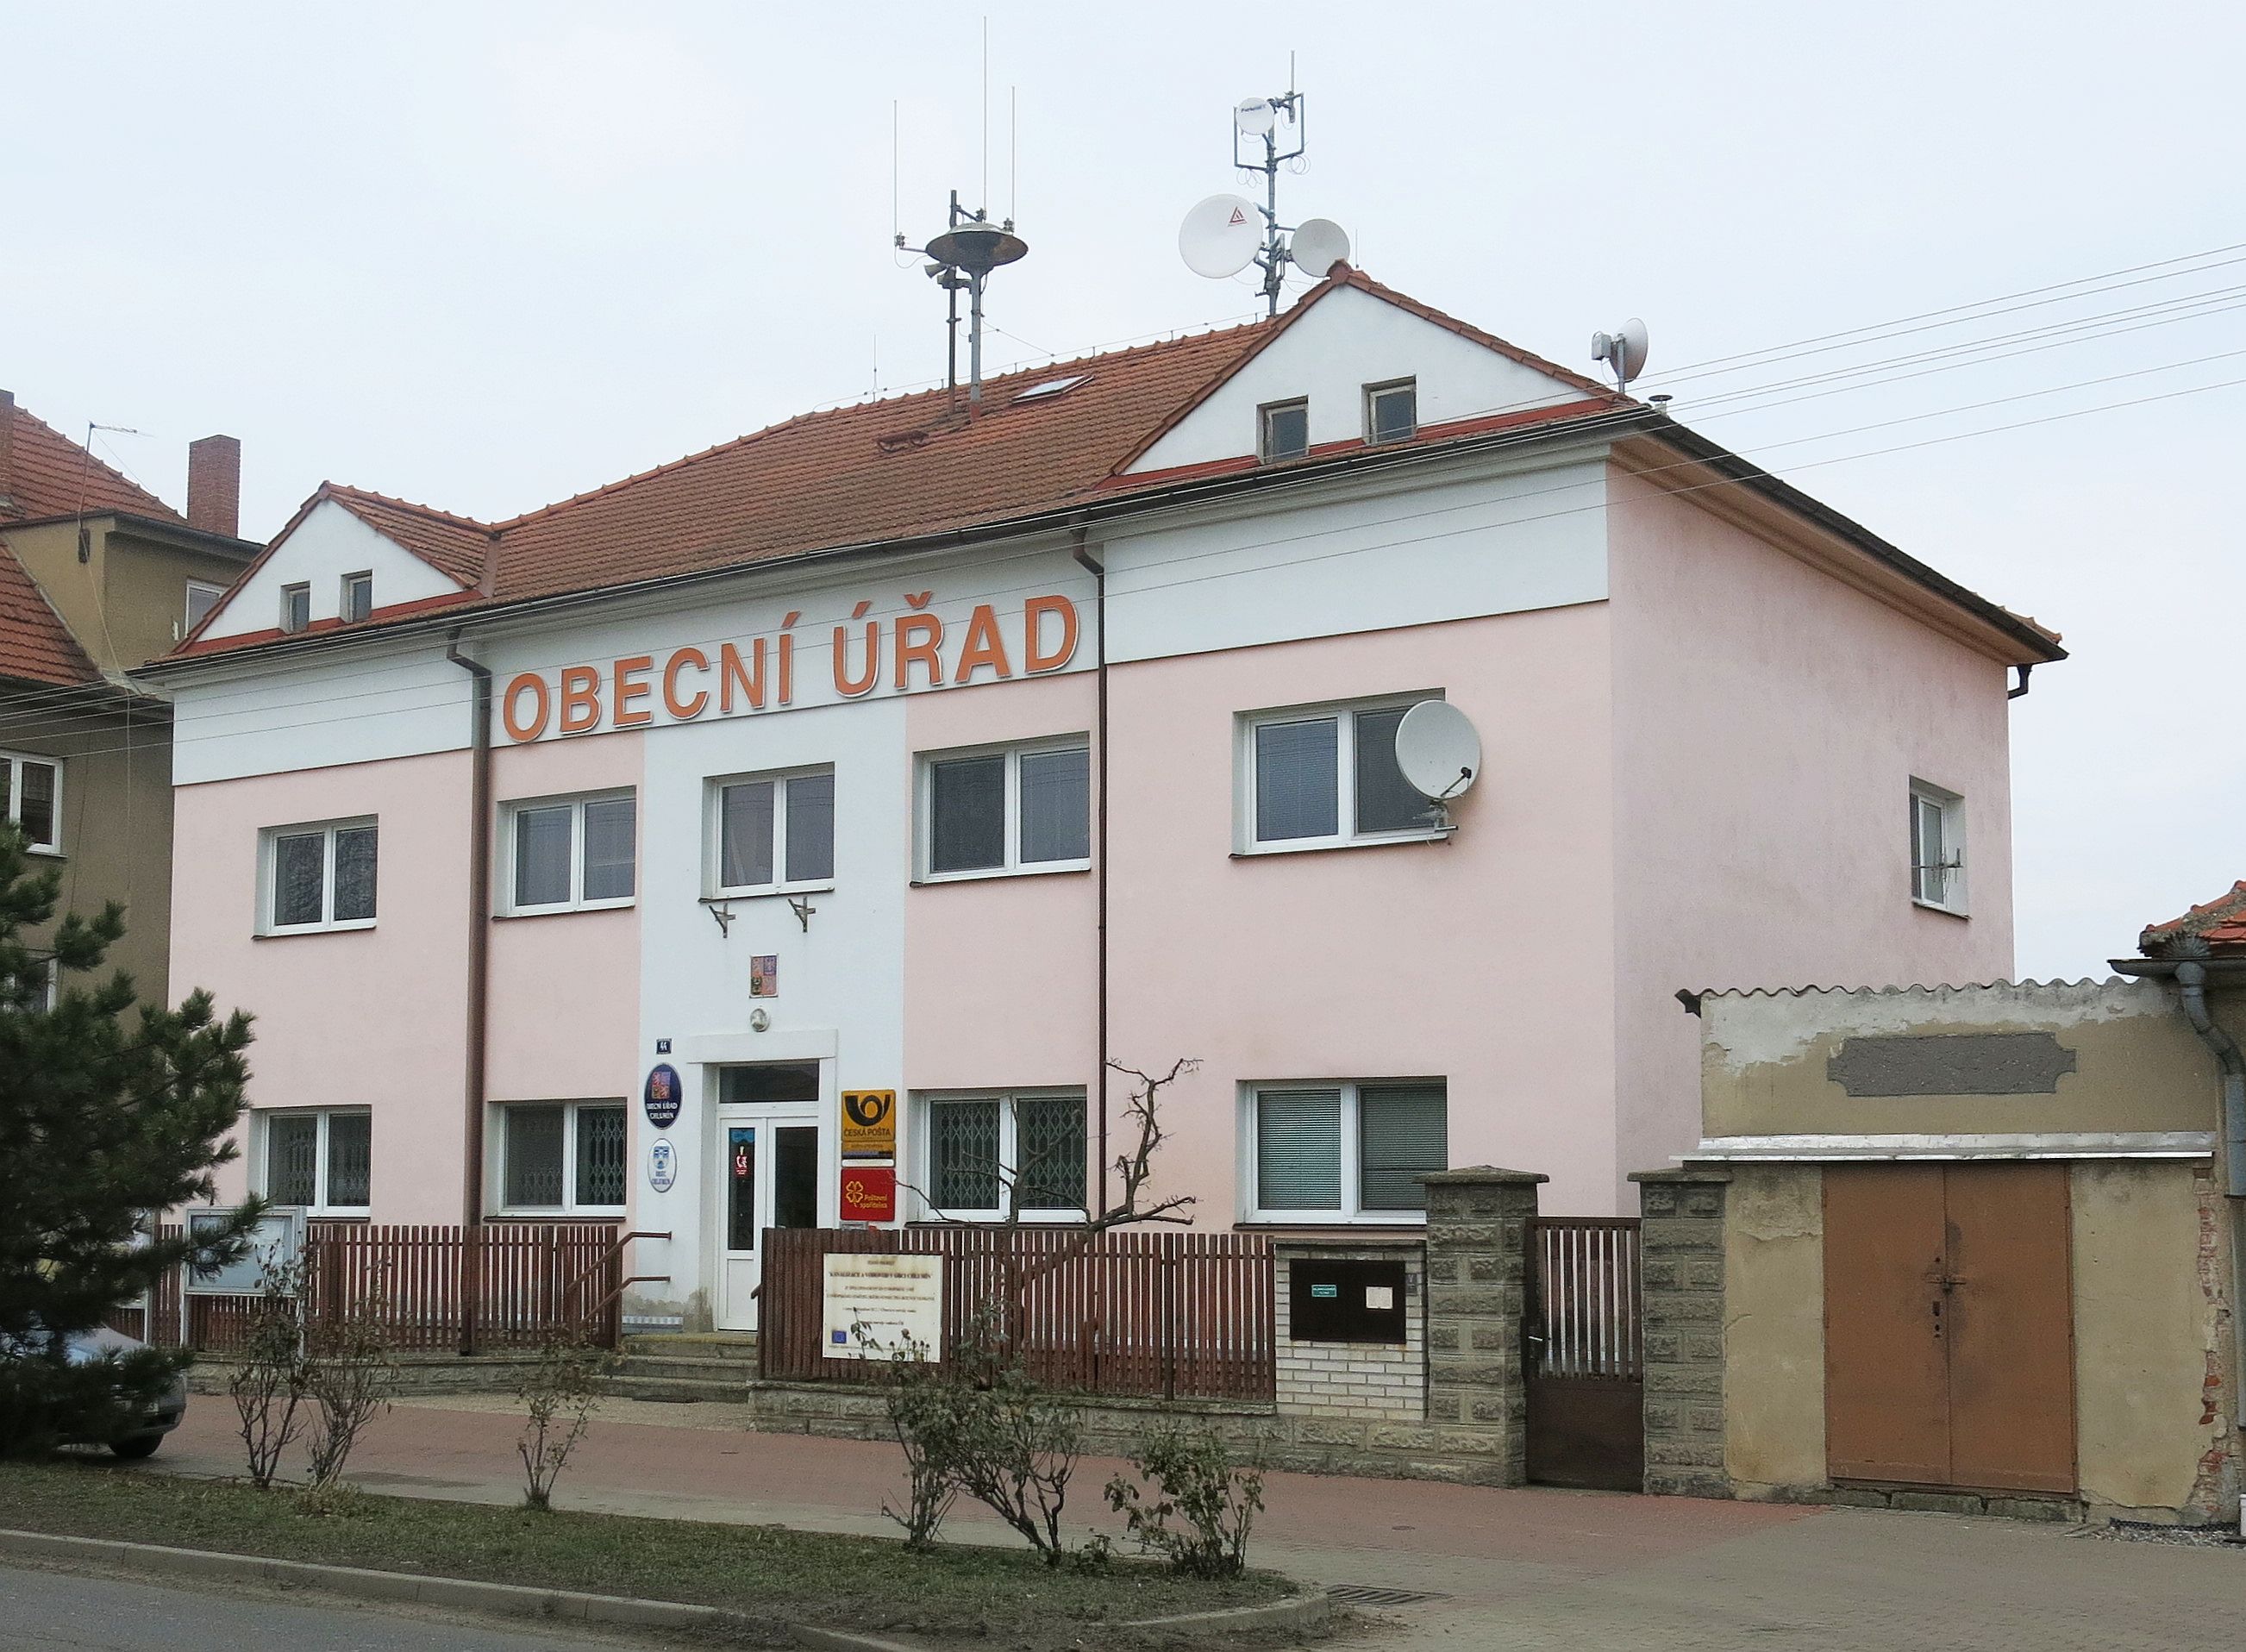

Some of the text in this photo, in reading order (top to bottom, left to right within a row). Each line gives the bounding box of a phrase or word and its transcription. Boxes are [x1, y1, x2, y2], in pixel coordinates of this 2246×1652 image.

[502, 590, 1081, 743] OBECNÍ ÚŘAD
[866, 1127, 892, 1136] POŠTA
